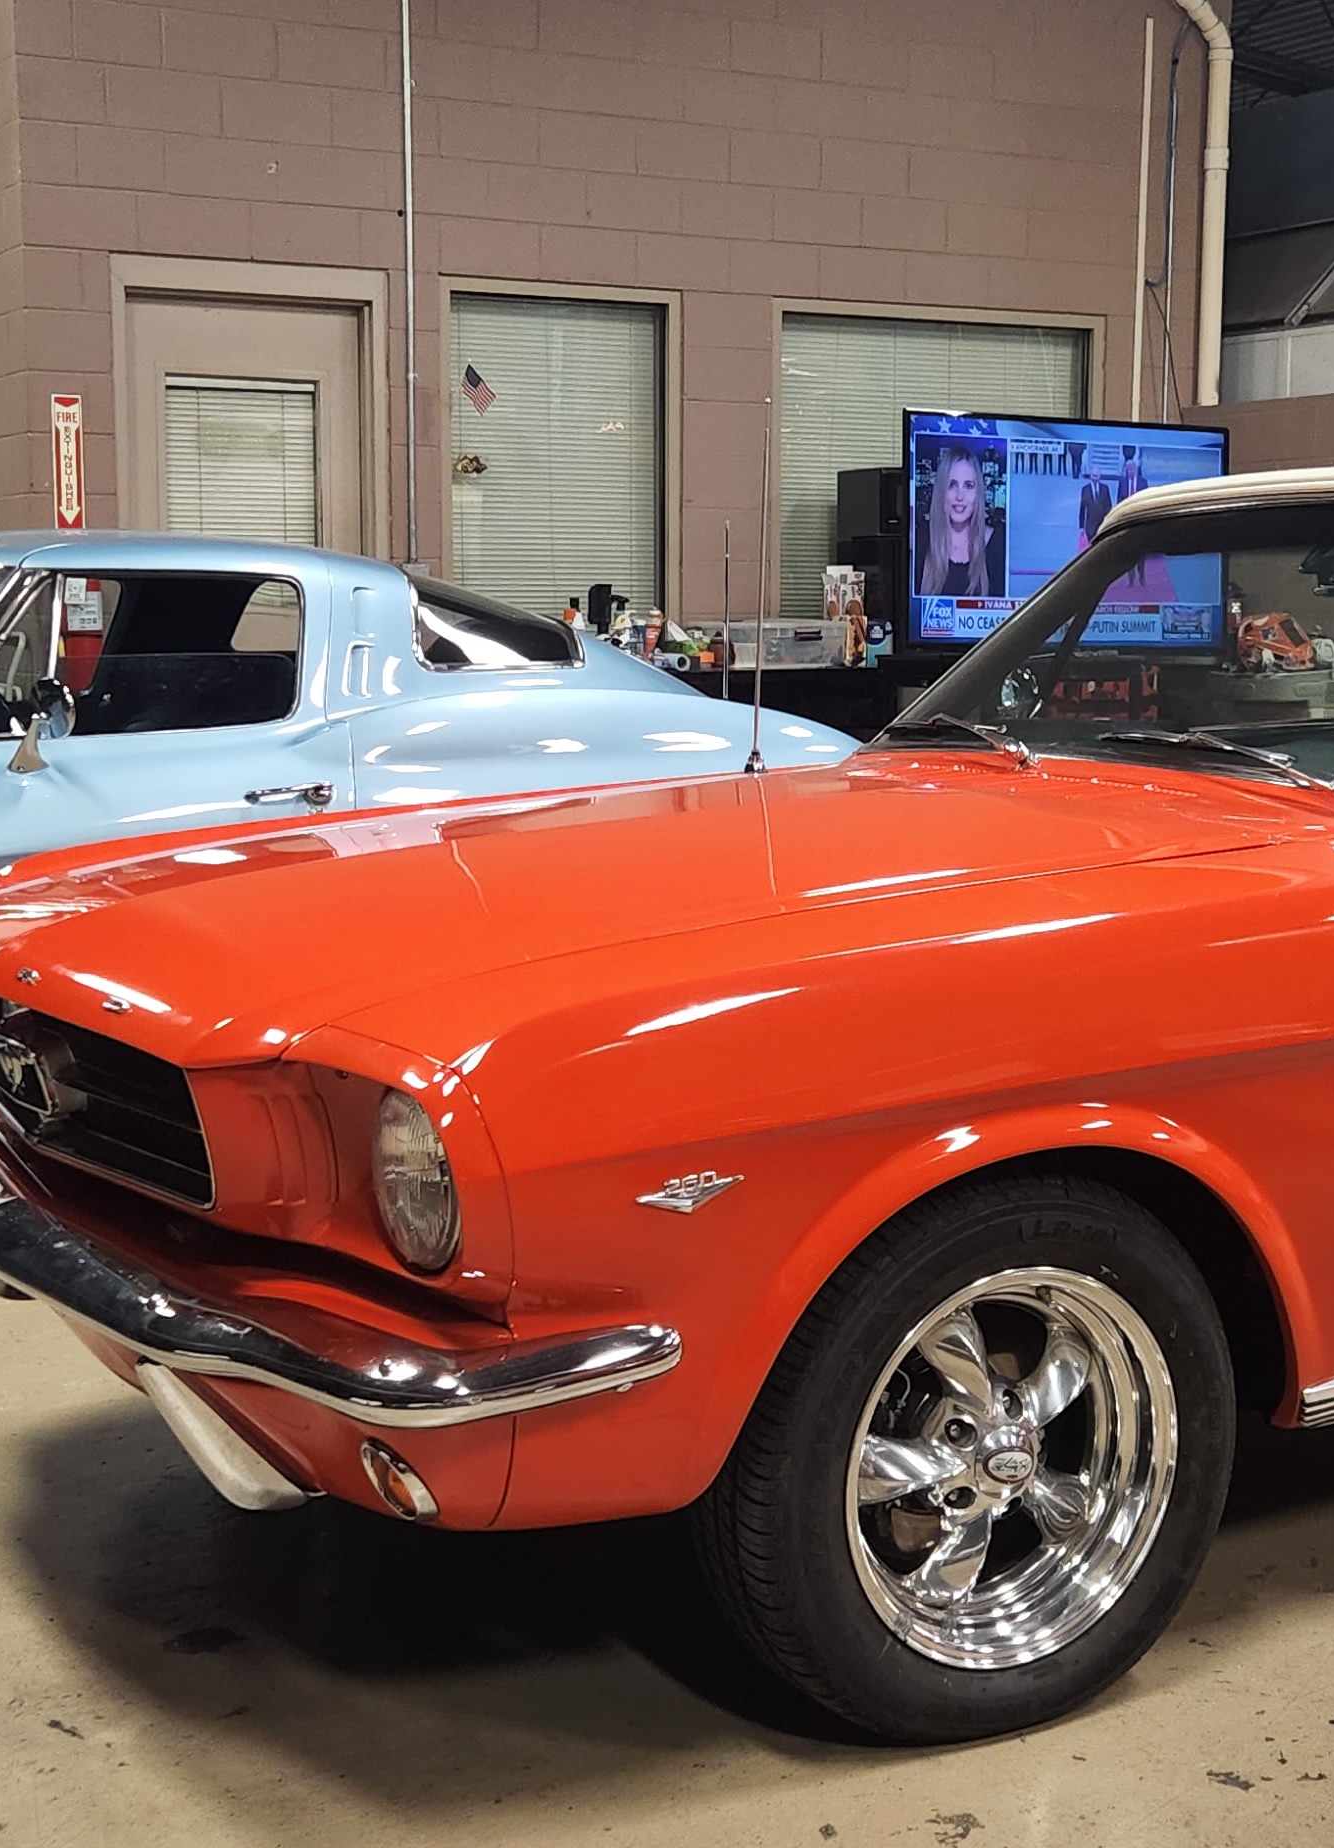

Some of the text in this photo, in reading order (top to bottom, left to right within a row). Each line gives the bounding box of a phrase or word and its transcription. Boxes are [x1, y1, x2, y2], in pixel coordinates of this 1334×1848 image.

[56, 411, 78, 424] FIRE
[984, 600, 1012, 609] IVANA
[932, 607, 952, 618] FOX
[927, 619, 954, 629] NEWS
[958, 616, 975, 630] NO
[1089, 620, 1118, 633] -PUTIN
[1121, 620, 1156, 633] SUMMIT
